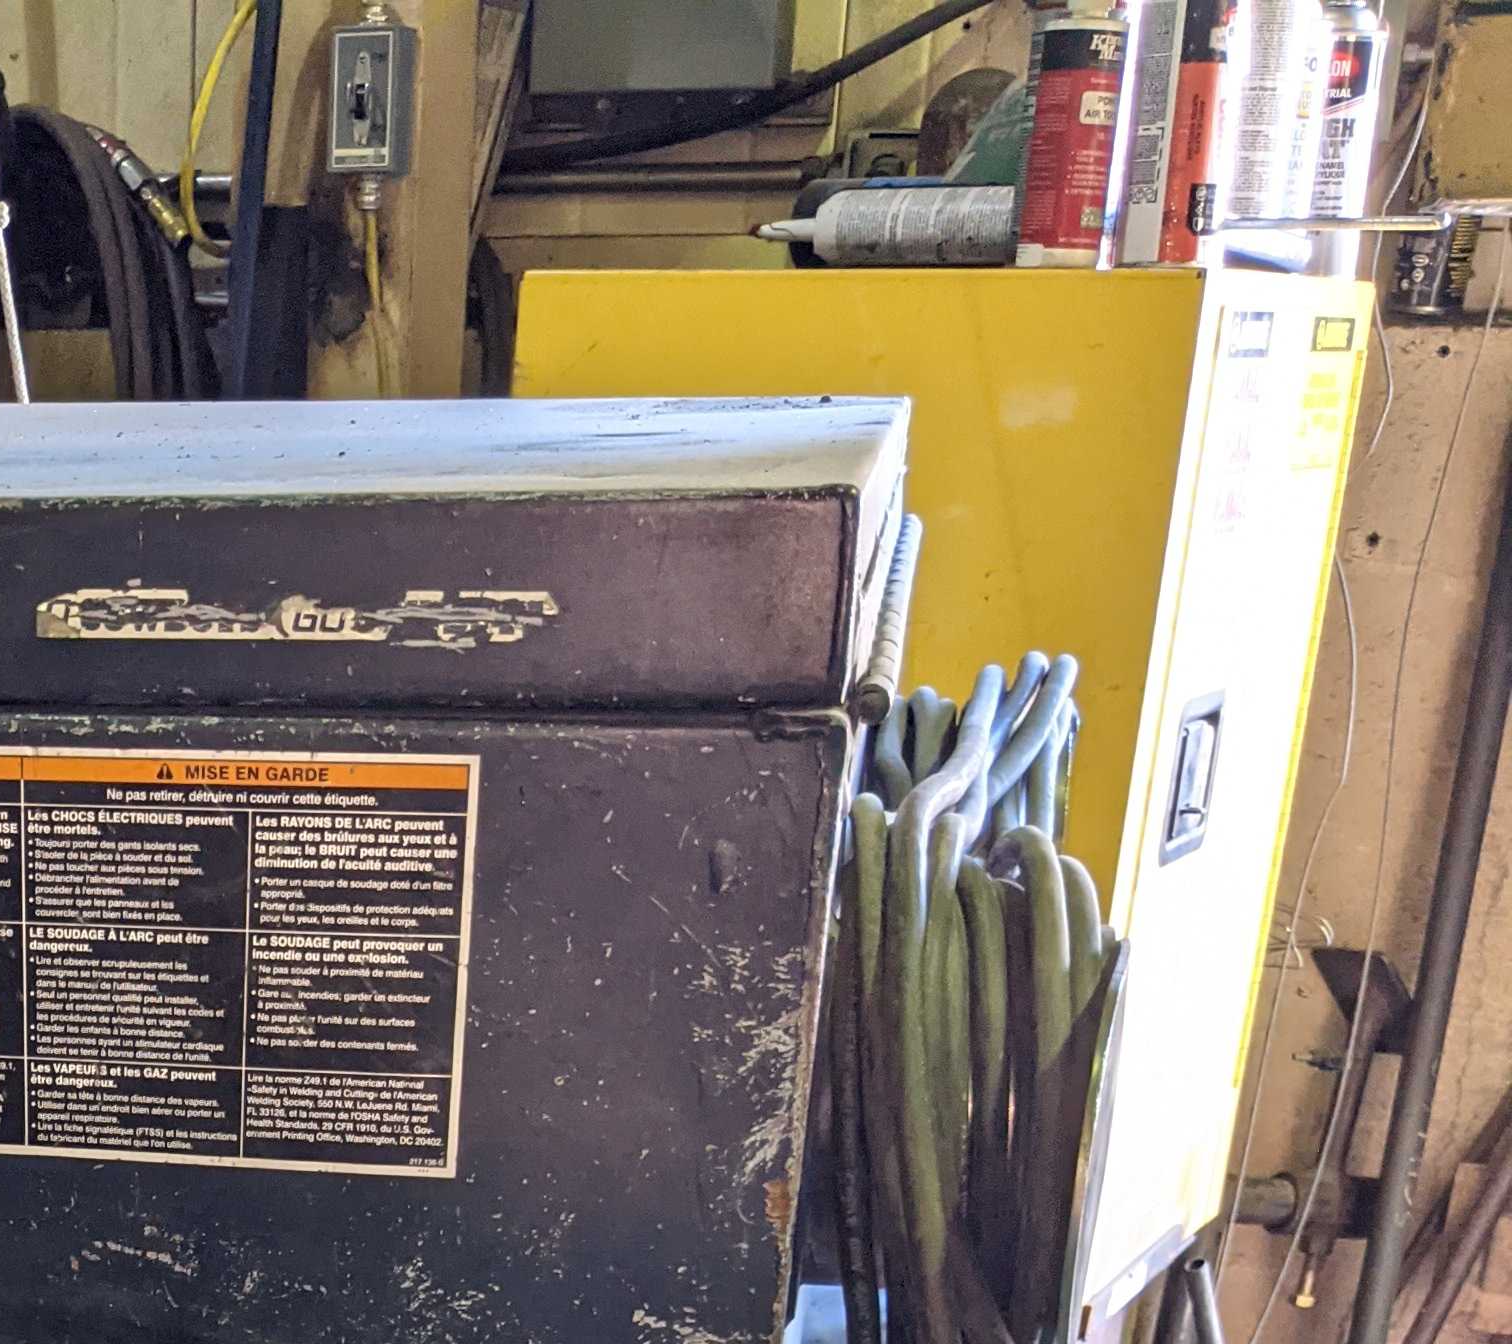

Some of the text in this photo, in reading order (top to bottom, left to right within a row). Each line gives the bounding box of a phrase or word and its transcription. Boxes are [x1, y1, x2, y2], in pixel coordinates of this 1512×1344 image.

[185, 765, 328, 782] MISE EN GARDE
[106, 788, 379, 809] Ne pas retirer, détruire ni couvrir cette étiquette.
[28, 810, 234, 828] Les CHOCS ÉLECTRIQUES peuvent
[256, 816, 278, 828] Les
[280, 817, 332, 829] RAYONS
[335, 818, 353, 829] DE
[396, 820, 444, 833] peuvent
[28, 823, 101, 835] être mortels.
[255, 830, 457, 847] causer des brûlures aux yeux et à
[255, 843, 458, 860] la peau; le BRUIT peut causer une
[254, 857, 319, 869] diminution
[321, 858, 336, 869] de
[384, 859, 435, 872] auditive.
[30, 928, 45, 939] LE
[48, 928, 107, 941] SOUDAGE
[109, 928, 119, 941] À
[159, 932, 185, 946] peut
[187, 932, 209, 944] être
[252, 936, 444, 953] Le SOUDAGE peut provoquer un
[30, 939, 92, 955] dangereux.
[252, 949, 302, 961] incendie
[305, 952, 321, 961] ou
[323, 953, 345, 962] une
